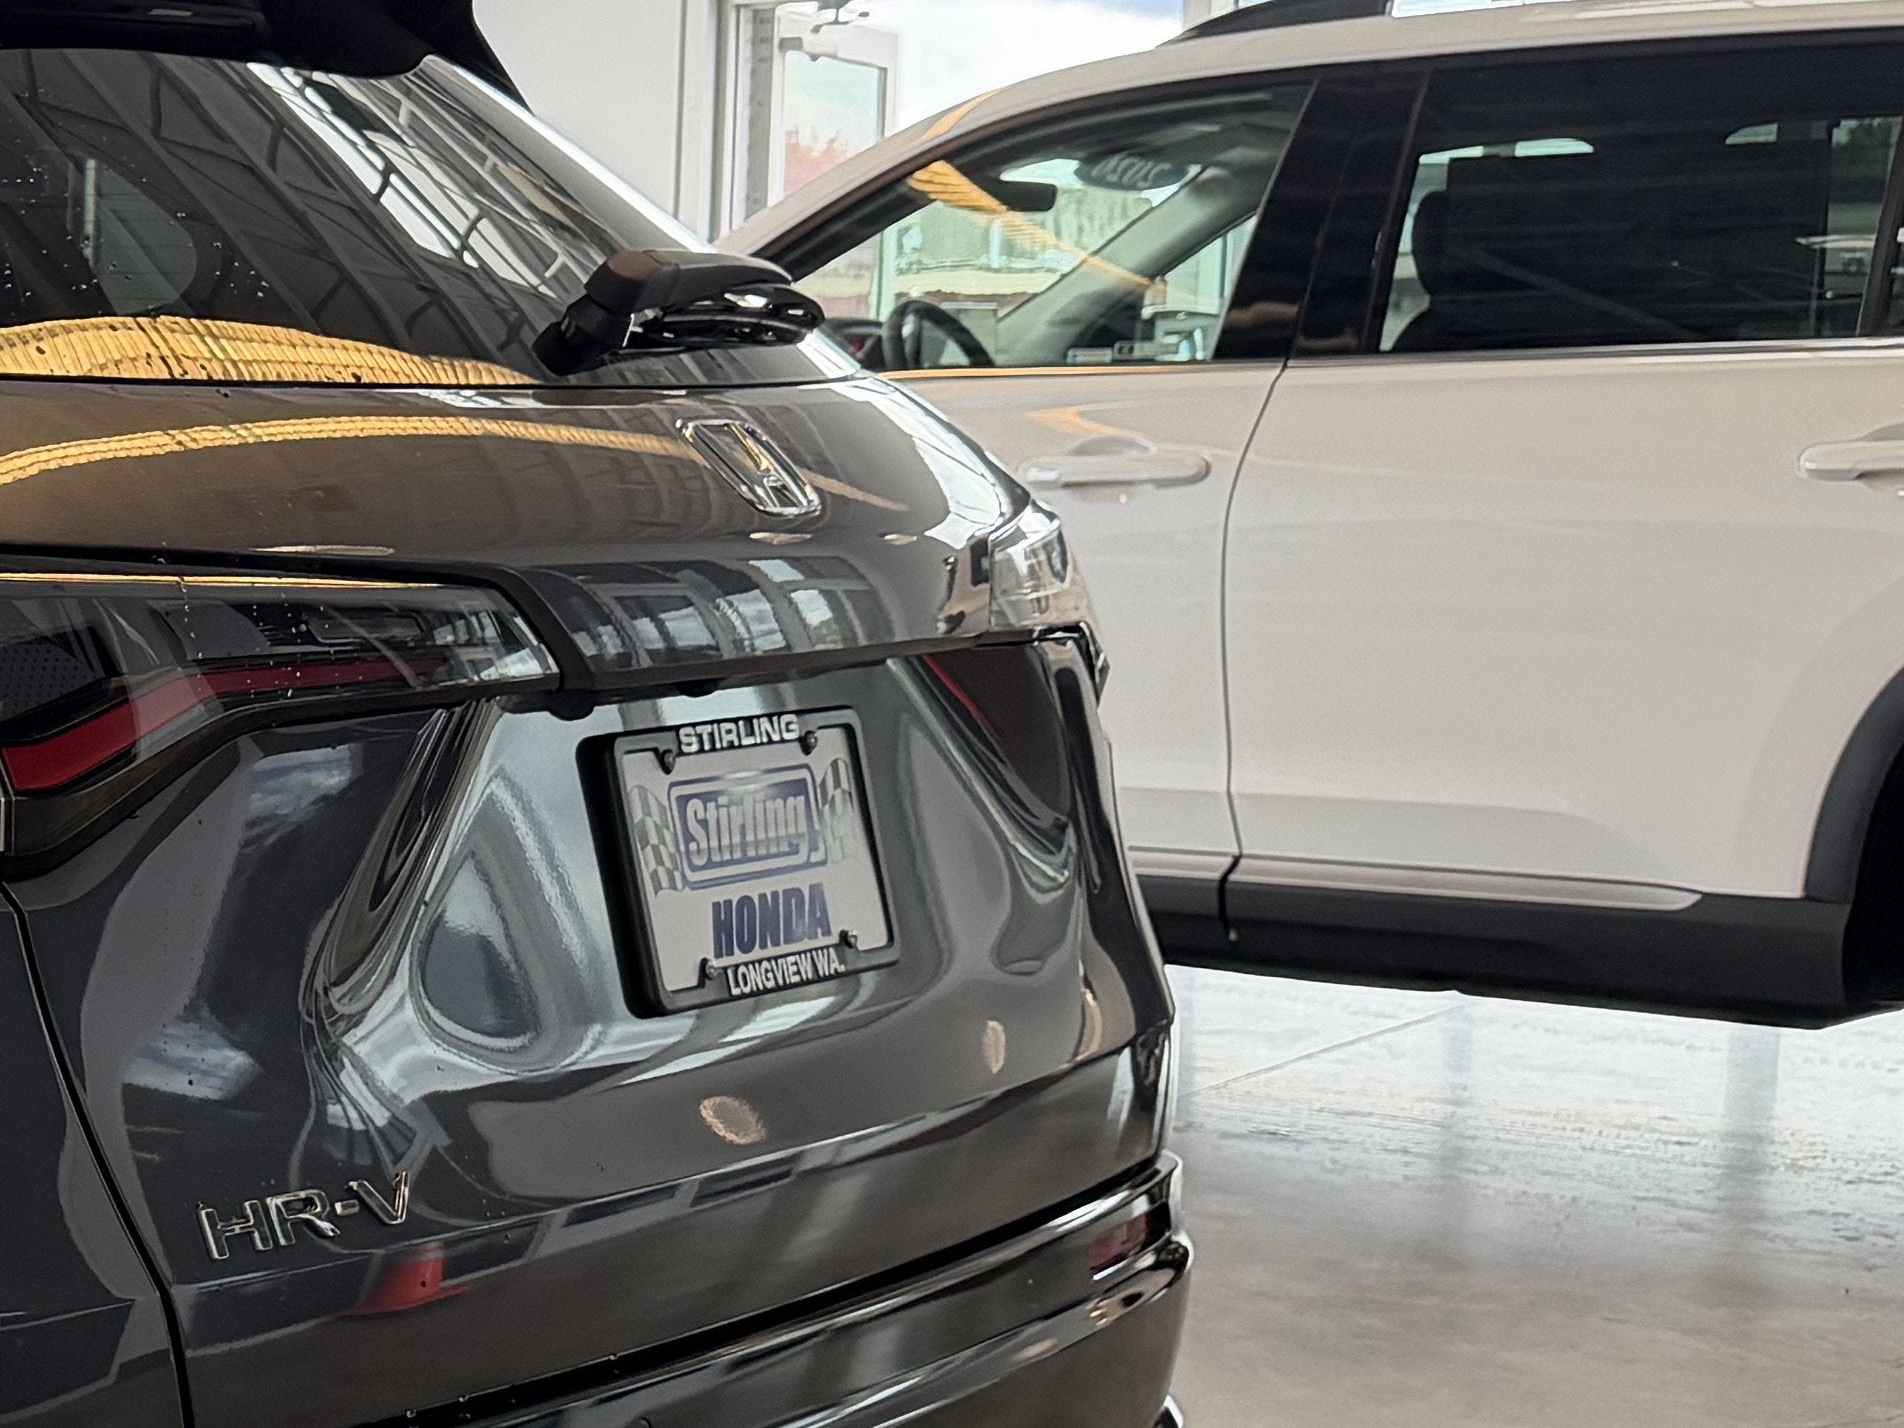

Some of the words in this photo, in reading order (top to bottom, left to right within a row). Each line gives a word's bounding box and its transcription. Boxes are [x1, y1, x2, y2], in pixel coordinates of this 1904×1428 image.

[678, 713, 801, 754] STIRLING
[685, 789, 809, 868] Stirling
[711, 882, 834, 960] HONDA
[726, 952, 814, 997] LONGVIEW
[196, 1171, 410, 1260] HR-V
